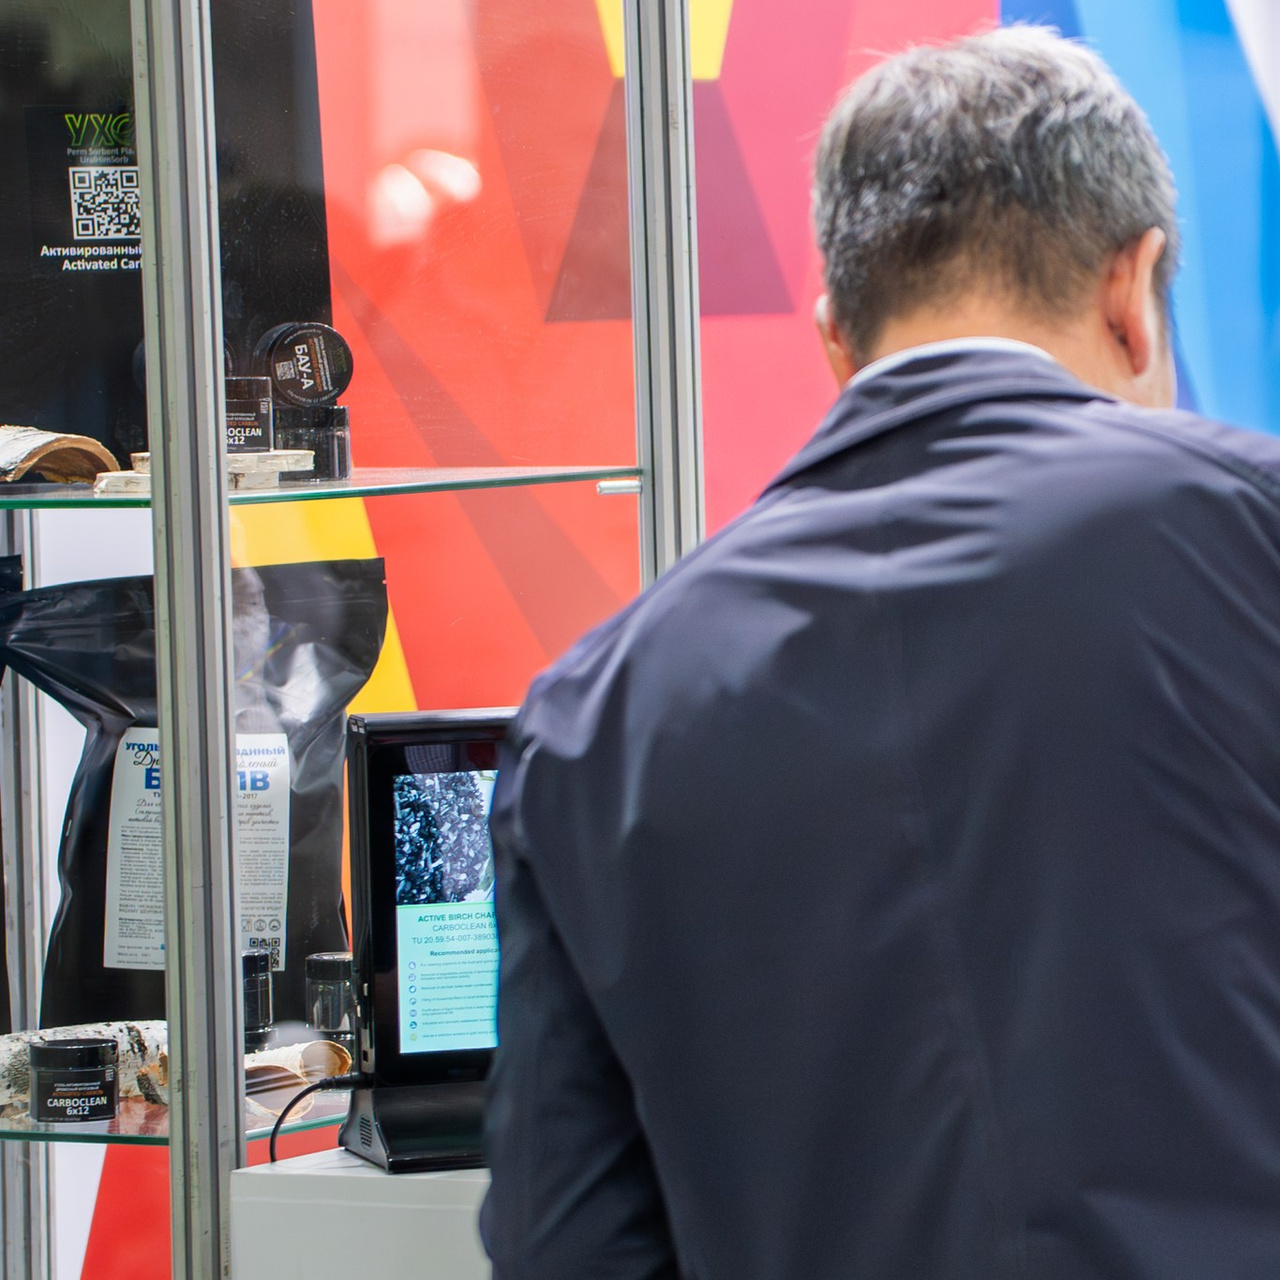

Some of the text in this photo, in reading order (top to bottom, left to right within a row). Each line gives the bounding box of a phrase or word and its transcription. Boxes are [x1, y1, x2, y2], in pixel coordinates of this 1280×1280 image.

[62, 258, 117, 270] Activated
[295, 344, 314, 390] БАУ-А
[226, 427, 262, 437] OCLEAN
[418, 913, 447, 923] ACTIVE
[448, 912, 473, 921] BIRCH
[433, 923, 487, 932] CARBOCLEAN
[412, 937, 423, 945] TU
[430, 948, 475, 957] Recommended
[47, 1097, 107, 1107] CARBOCLEAN
[66, 1106, 90, 1115] 6x12
